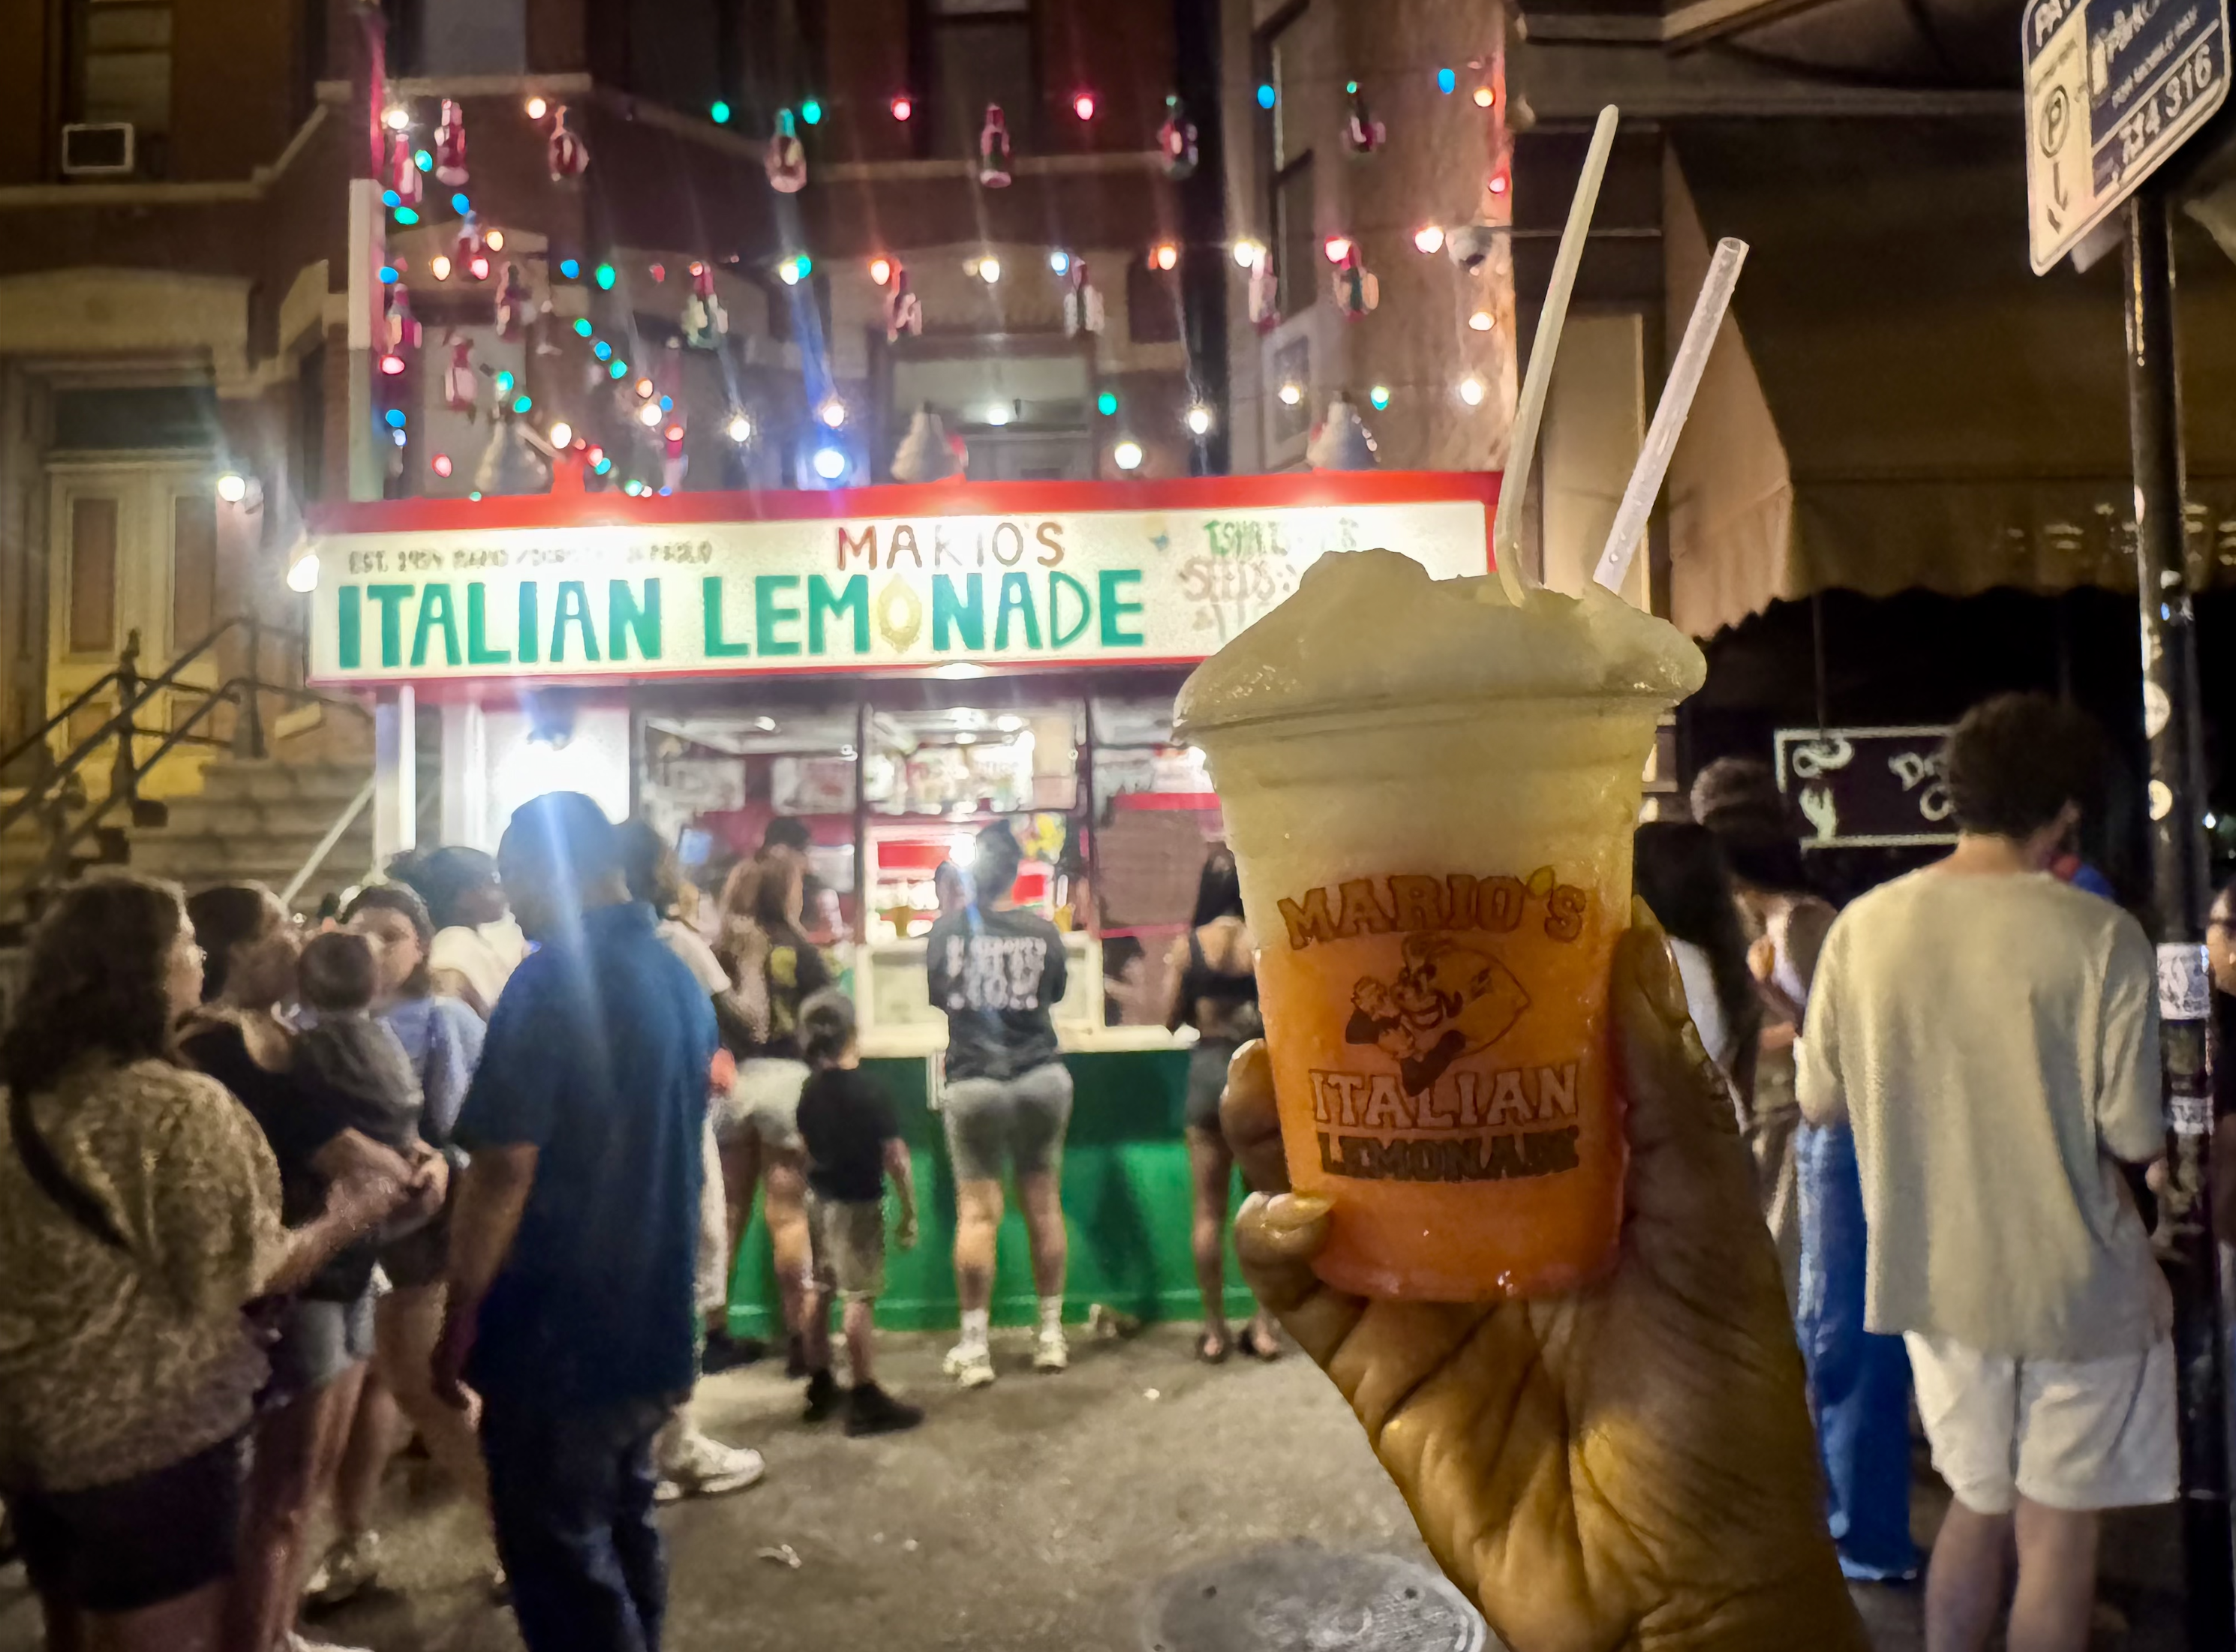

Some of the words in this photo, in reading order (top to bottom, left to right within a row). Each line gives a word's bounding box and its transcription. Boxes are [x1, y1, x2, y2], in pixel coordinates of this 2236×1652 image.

[836, 521, 1065, 568] MARIO'S
[338, 577, 663, 669] ITALIAN
[702, 568, 1144, 654] LEMONADE
[1277, 873, 1586, 950] MARIO'S
[1309, 1064, 1580, 1126] ITALIAN
